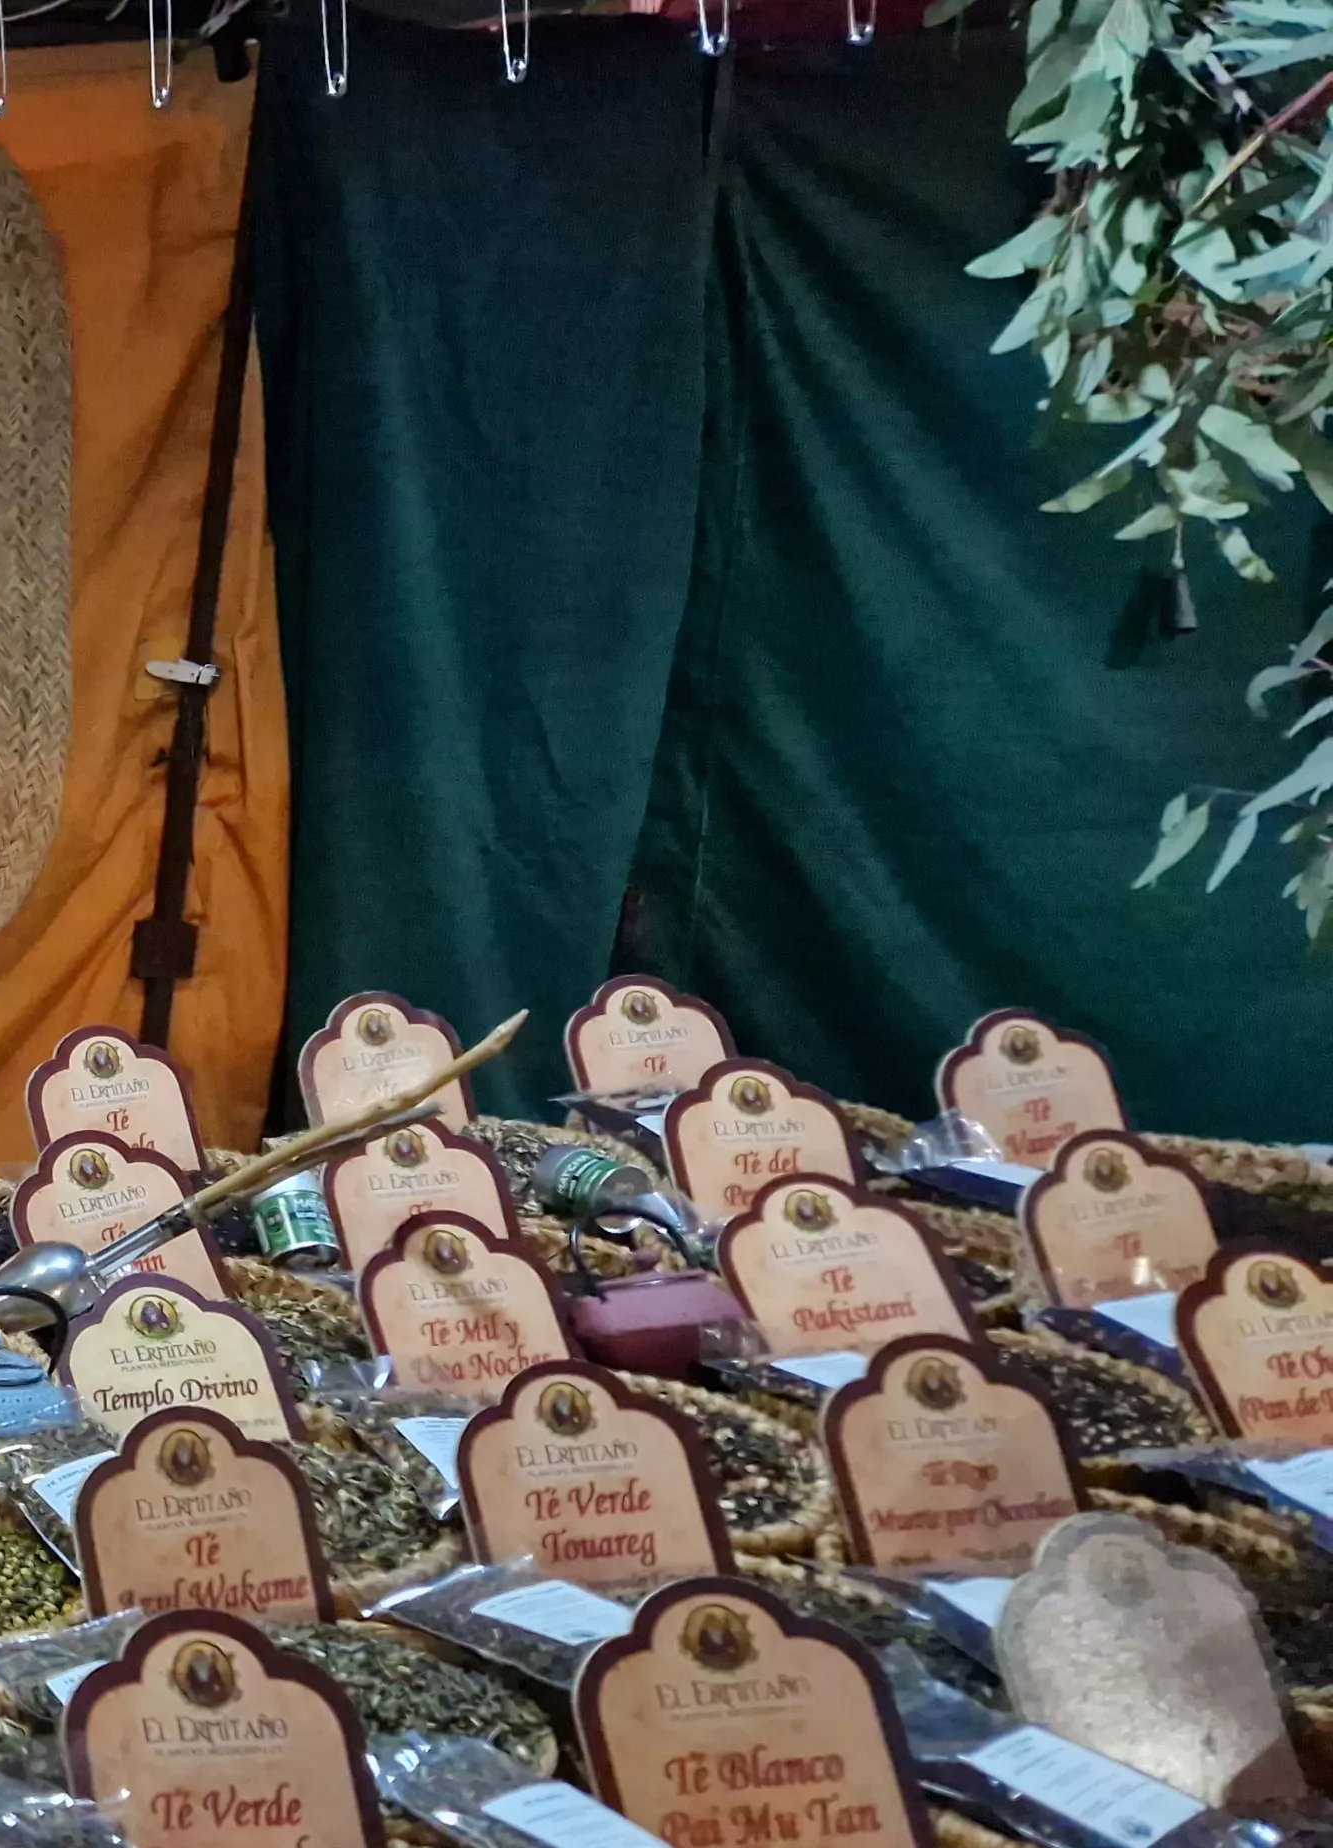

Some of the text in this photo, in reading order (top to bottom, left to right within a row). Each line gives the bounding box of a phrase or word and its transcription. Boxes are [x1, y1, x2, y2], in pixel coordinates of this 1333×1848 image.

[645, 1055, 667, 1073] Té
[71, 1087, 87, 1102] EL
[107, 1108, 129, 1132] Té
[735, 1148, 801, 1174] Té del
[58, 1184, 146, 1219] EL ERMITAÑO
[822, 1267, 855, 1293] Té
[422, 1313, 519, 1349] Té Mil y
[110, 1339, 216, 1365] EL ERMITAÑO
[93, 1373, 258, 1413] Templo Divino
[525, 1477, 651, 1521] Té Verde
[185, 1530, 221, 1568] Té
[543, 1530, 655, 1566] Touareg
[188, 1569, 308, 1613] Wakame
[142, 1718, 168, 1743] EL
[664, 1744, 845, 1796] Té Blanco
[151, 1781, 302, 1831] Té Verde
[731, 1803, 799, 1844] Mu
[806, 1793, 882, 1836] Tan
